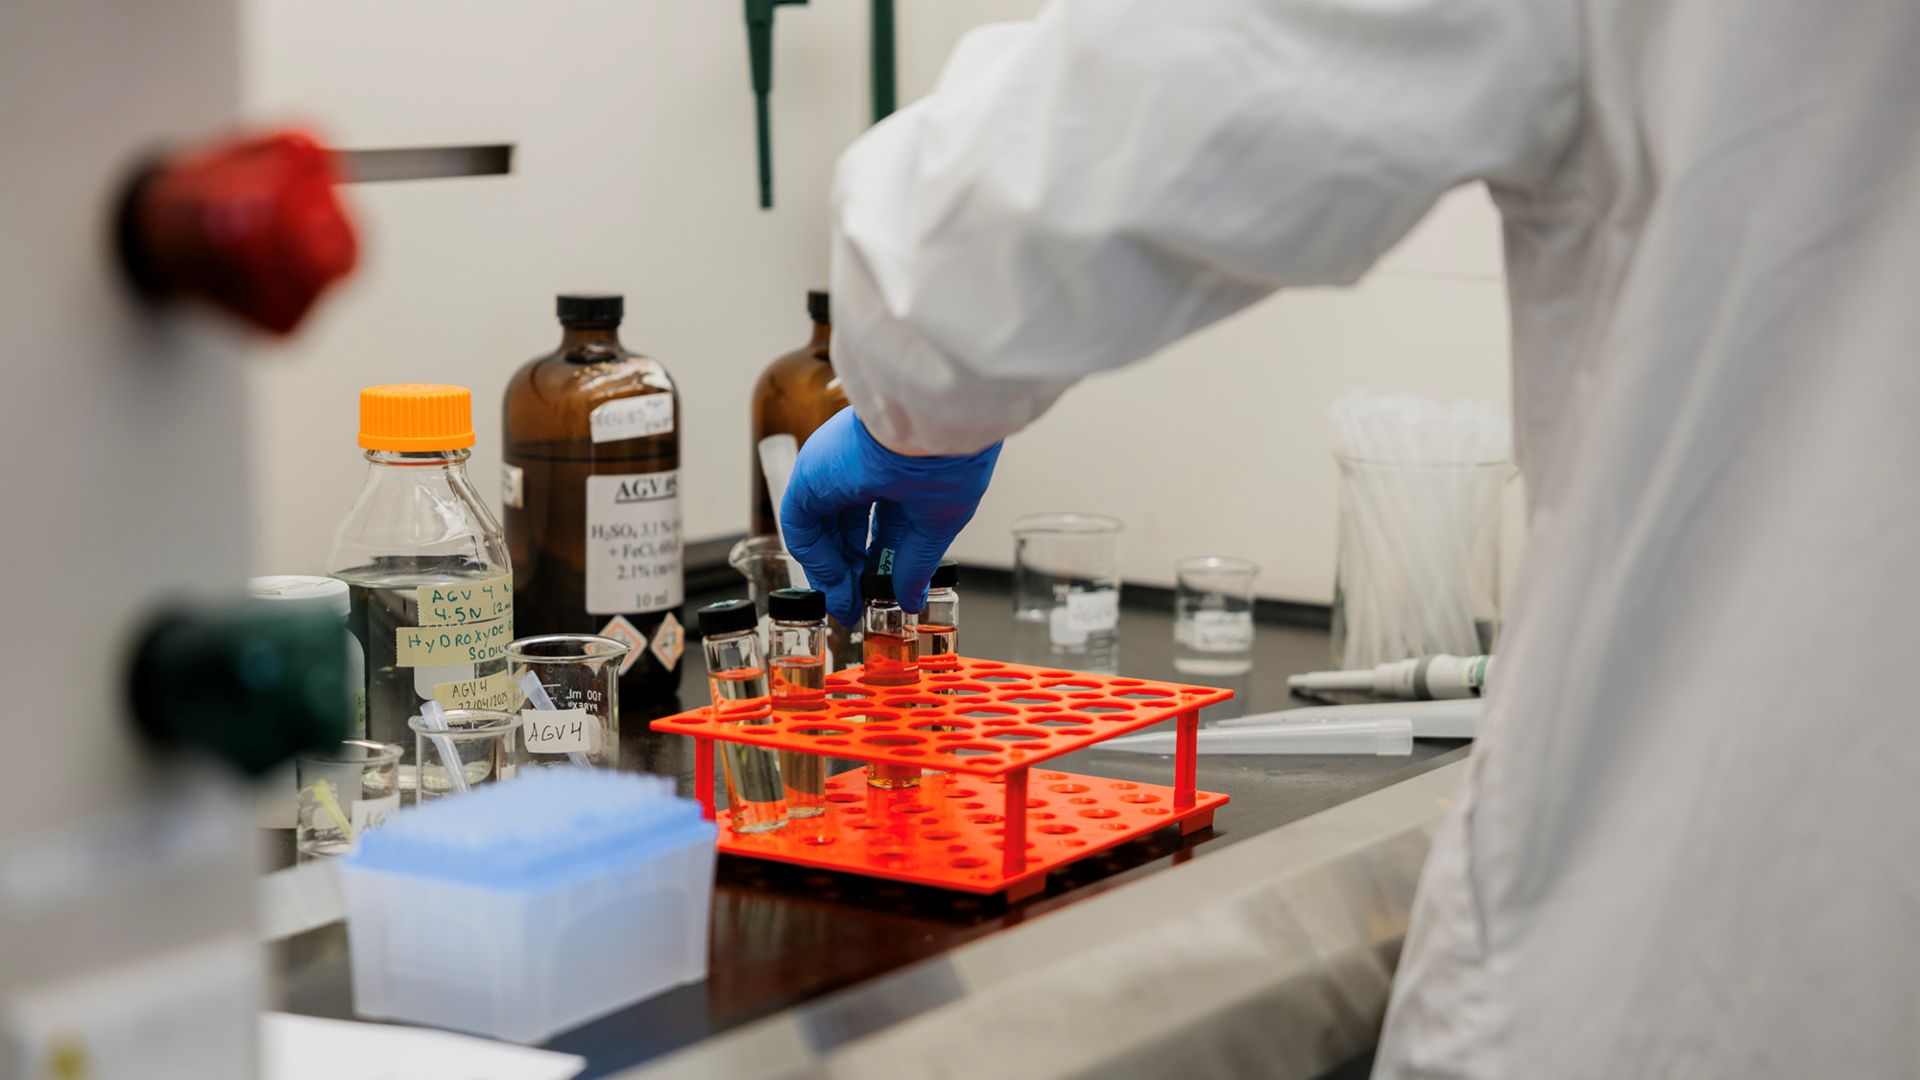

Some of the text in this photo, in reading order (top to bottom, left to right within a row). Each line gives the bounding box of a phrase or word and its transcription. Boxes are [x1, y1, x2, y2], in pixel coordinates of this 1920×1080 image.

[615, 478, 661, 499] AGV
[432, 589, 472, 603] AGV
[482, 585, 493, 599] 4
[452, 679, 488, 698] AGV 4
[528, 721, 583, 742] AGV 4
